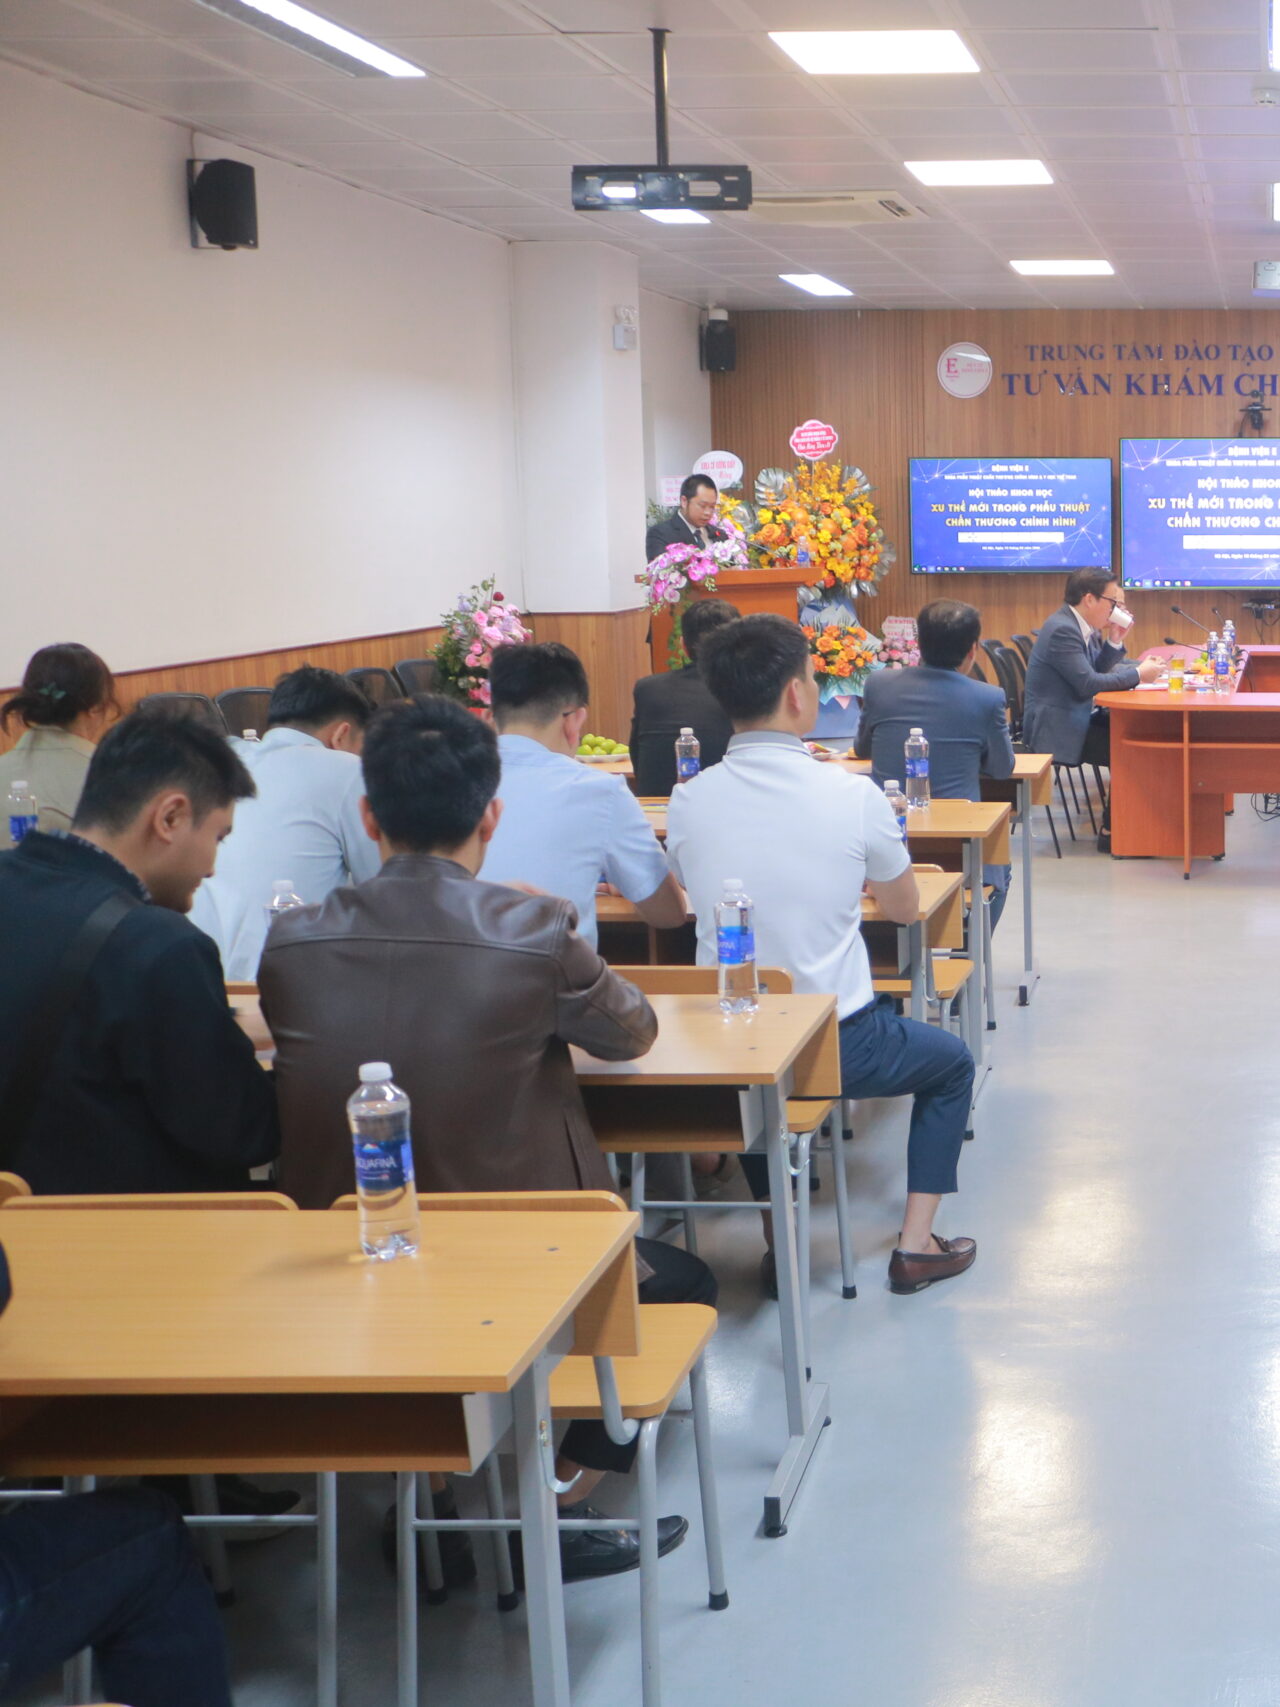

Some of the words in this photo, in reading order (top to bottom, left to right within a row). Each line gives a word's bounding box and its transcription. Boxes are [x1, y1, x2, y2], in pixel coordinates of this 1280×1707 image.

[1024, 344, 1105, 362] TRUNG
[1174, 338, 1222, 361] ĐÀO
[1227, 344, 1275, 367] TẠO
[1002, 369, 1048, 396] TƯ
[1126, 367, 1224, 396] KHÁM
[1197, 476, 1218, 491] HỘI
[1220, 476, 1250, 489] THẢO
[968, 487, 984, 499] HỘI
[986, 487, 1008, 497] THẢO
[1010, 489, 1033, 497] KHOA
[1036, 489, 1053, 499] HỌC
[1148, 498, 1166, 509] XU
[1170, 492, 1194, 509] THẾ
[1198, 495, 1224, 509] MỚI
[1228, 498, 1274, 509] TRONG
[931, 504, 945, 512] XU
[948, 499, 966, 512] THẾ
[969, 501, 988, 512] MỚI
[992, 503, 1026, 512] TRONG
[1030, 500, 1056, 512] PHẪU
[1060, 502, 1090, 514] THUẬT
[945, 514, 972, 526] CHẤN
[975, 517, 1017, 526] THƯƠNG
[1020, 515, 1050, 526] CHỈNH
[1052, 515, 1076, 526] HÌNH
[1167, 511, 1201, 528] CHẤN
[1204, 516, 1260, 528] THƯƠNG
